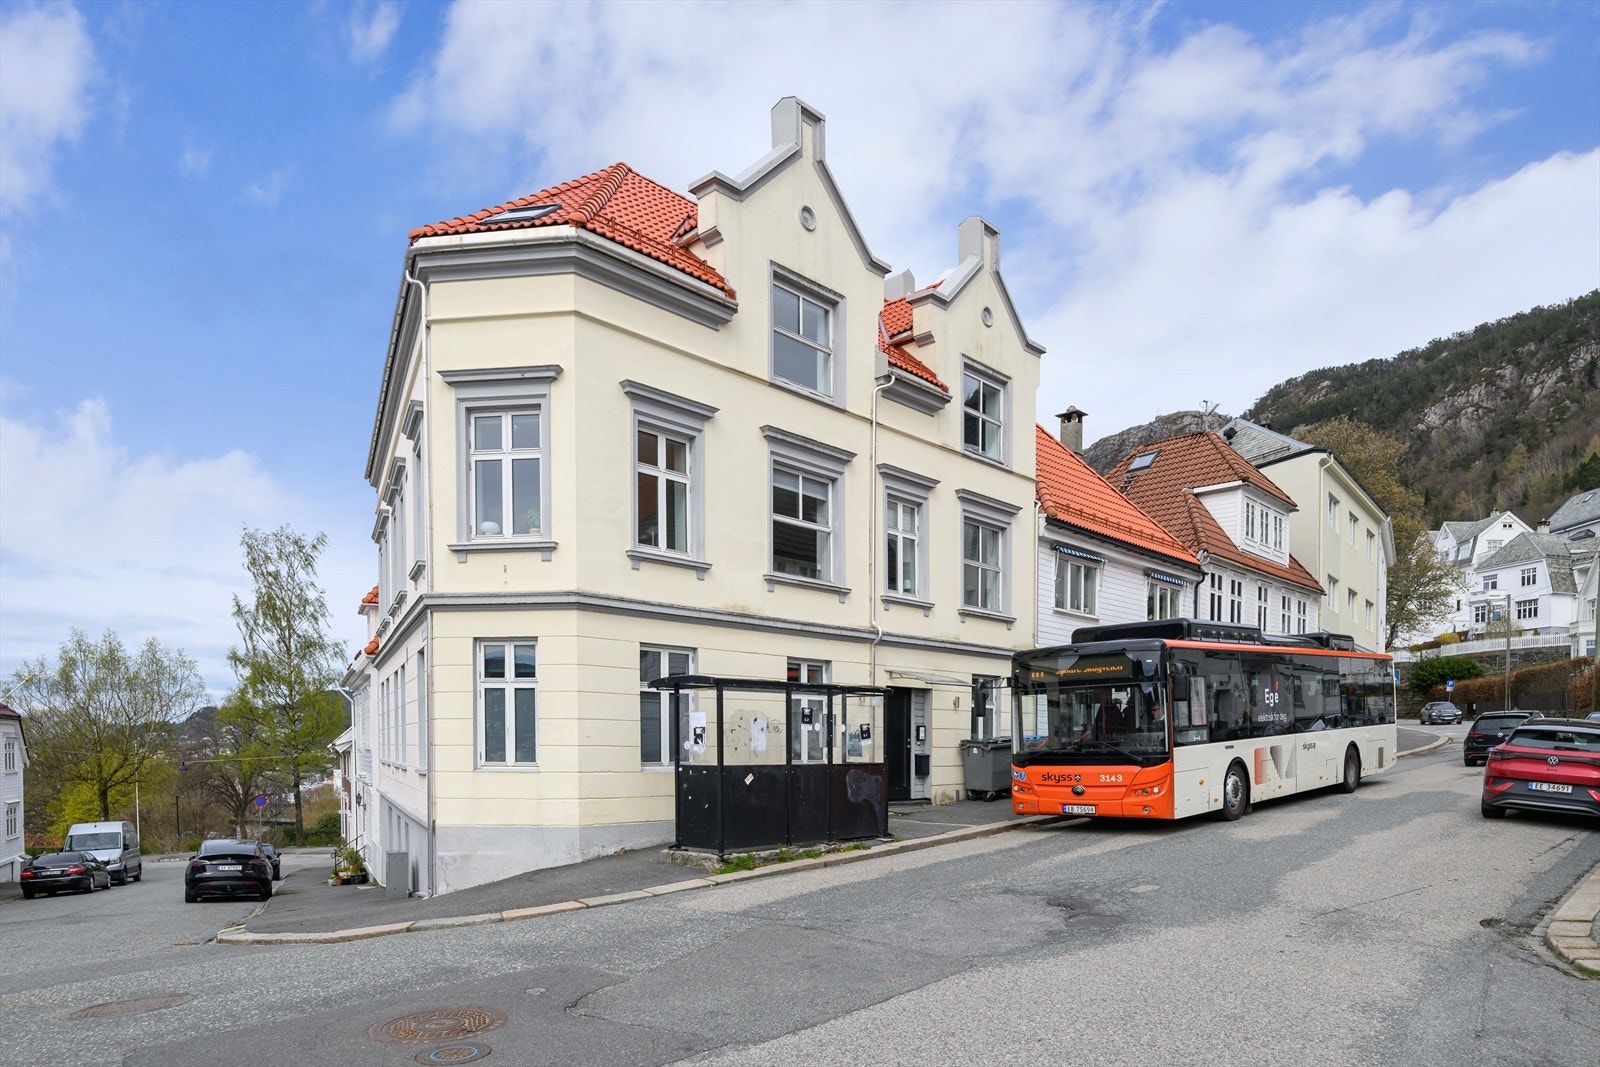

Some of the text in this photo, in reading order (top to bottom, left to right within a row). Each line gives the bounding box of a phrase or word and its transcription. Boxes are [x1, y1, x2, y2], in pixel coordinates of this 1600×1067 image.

[1041, 772, 1123, 784] skyss 3143
[1534, 782, 1570, 792] EE 34691
